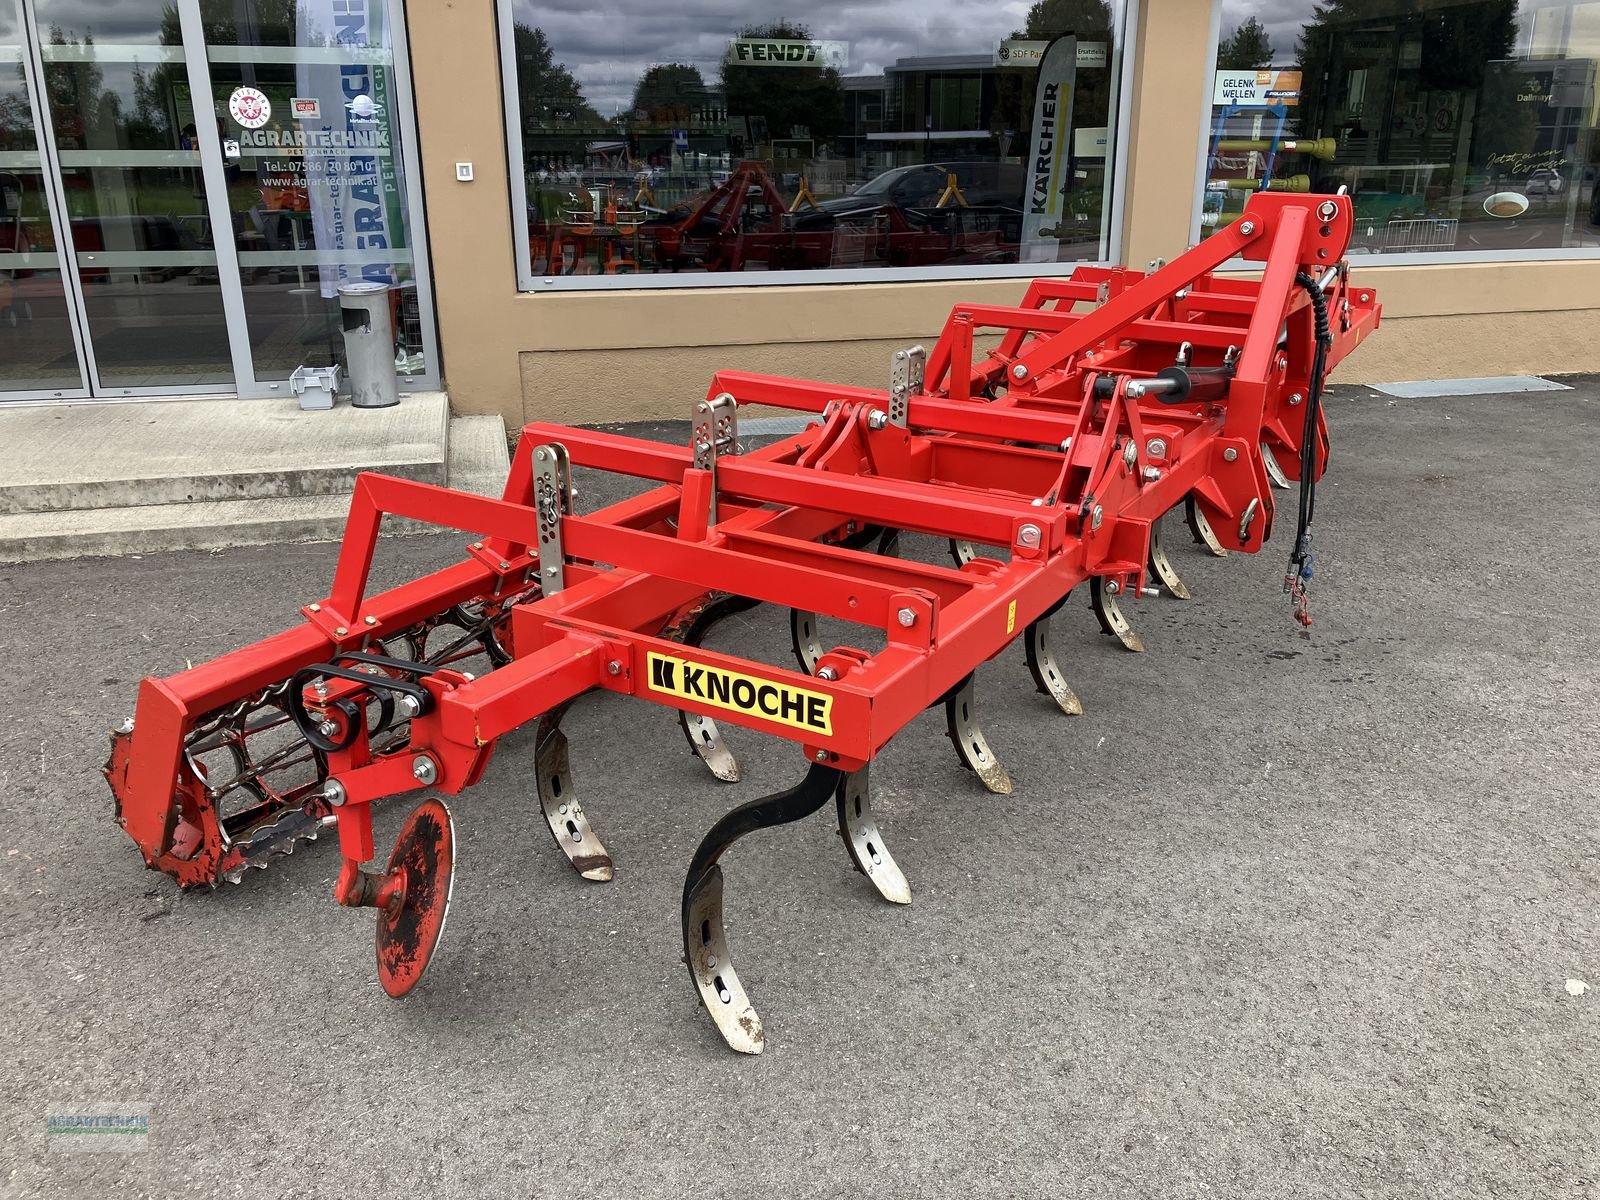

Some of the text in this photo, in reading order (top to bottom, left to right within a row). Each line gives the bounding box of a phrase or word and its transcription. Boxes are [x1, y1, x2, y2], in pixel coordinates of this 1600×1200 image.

[735, 43, 822, 62] FENDT
[1013, 49, 1027, 58] SDF
[1223, 79, 1254, 88] GELENK
[1223, 90, 1255, 98] WELLEN
[1517, 94, 1553, 103] Dallmayr
[373, 69, 396, 192] PETNBACH
[240, 130, 389, 146] AGRARTECHNIK
[1031, 82, 1059, 214] KÄRCHER
[264, 161, 287, 171] Tel.:
[289, 161, 322, 172] 07586
[328, 161, 341, 172] 20
[343, 161, 357, 172] 80
[360, 161, 372, 172] 10
[262, 176, 378, 188] www.agrar-technik.at
[683, 665, 827, 729] KNOCHE
